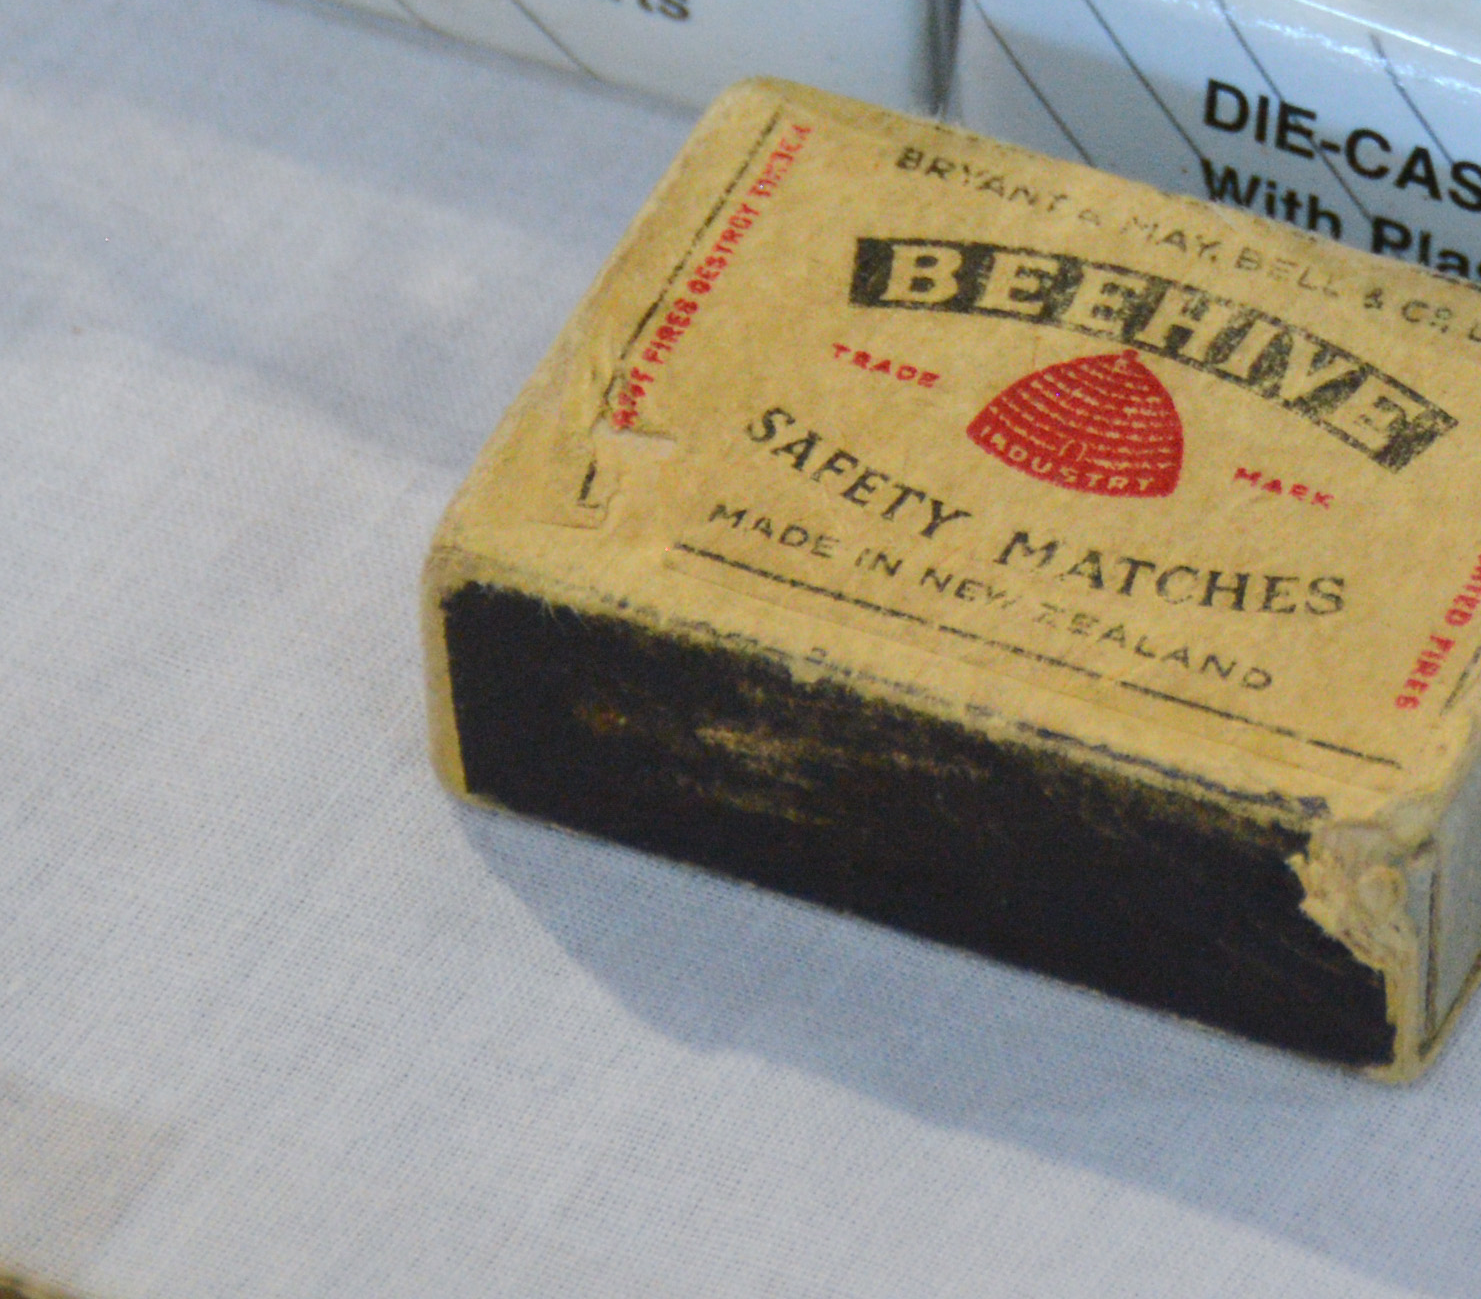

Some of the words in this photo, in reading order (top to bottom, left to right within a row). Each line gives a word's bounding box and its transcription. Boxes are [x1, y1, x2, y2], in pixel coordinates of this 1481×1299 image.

[895, 146, 1068, 213] BRYANT
[1236, 248, 1338, 300] BELL
[1202, 158, 1342, 240] With
[832, 341, 940, 388] TRADE
[1232, 467, 1335, 510] MARK
[878, 241, 1415, 457] BEEHIVE
[745, 405, 972, 541] SAFETY
[993, 528, 1347, 618] MATCHES
[980, 425, 1156, 492] INDUSTRY
[708, 502, 840, 560] MADE
[854, 546, 904, 579] IN
[920, 565, 1016, 608] NEW
[1033, 602, 1274, 693] ZEALAND
